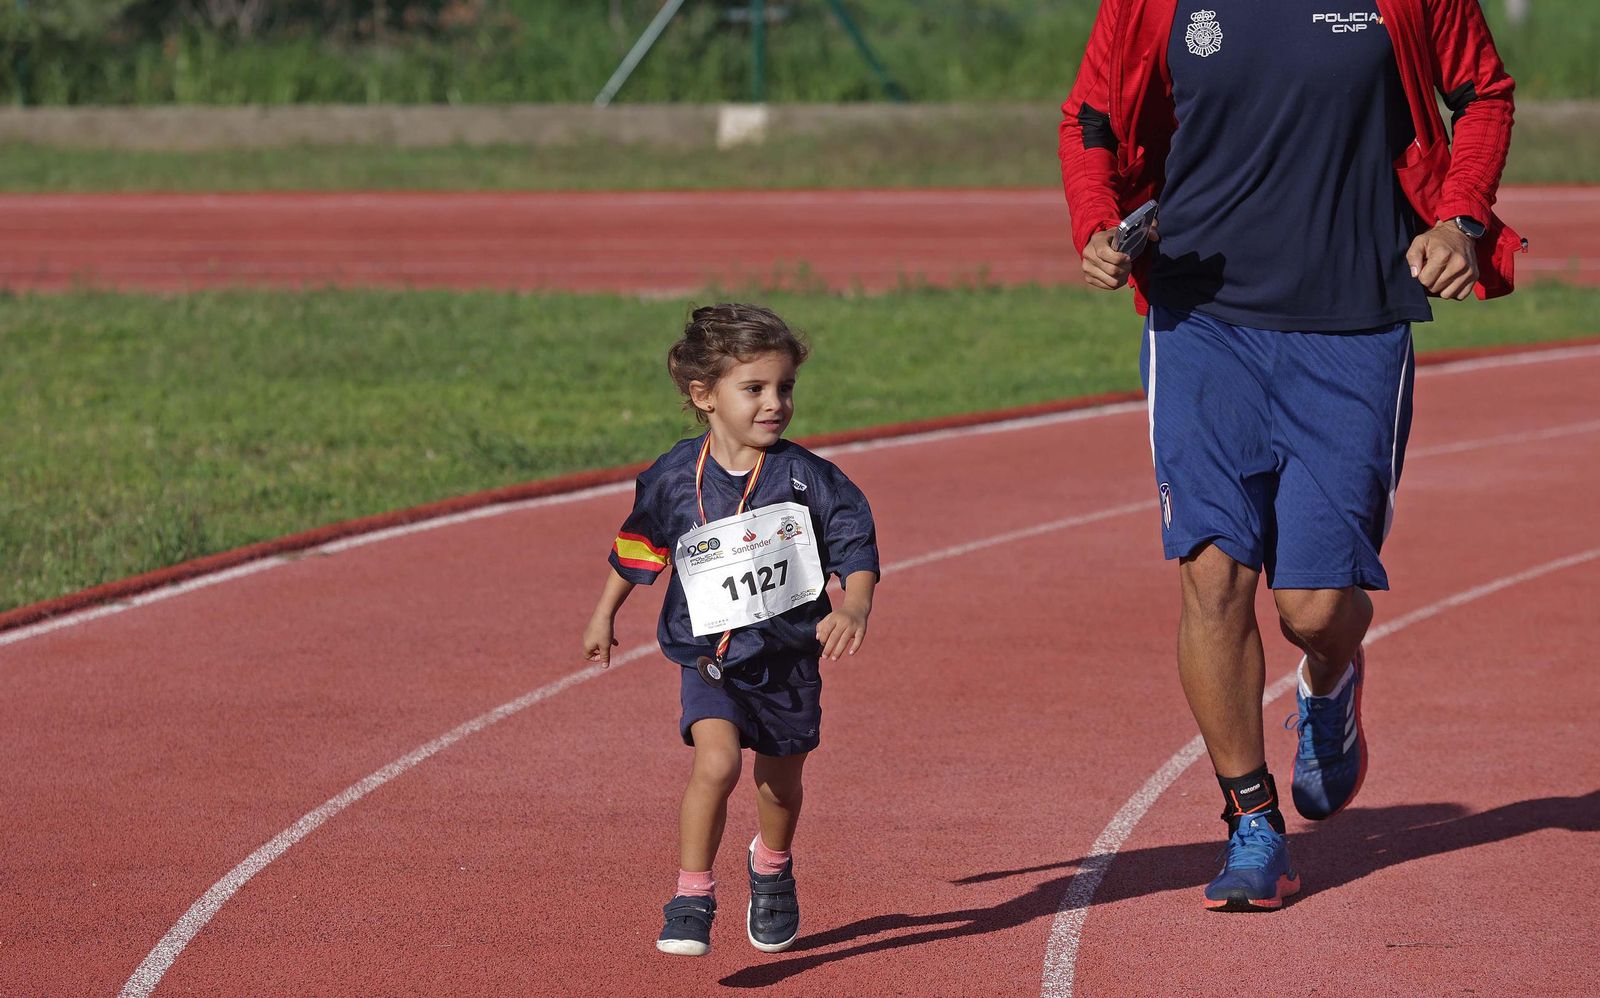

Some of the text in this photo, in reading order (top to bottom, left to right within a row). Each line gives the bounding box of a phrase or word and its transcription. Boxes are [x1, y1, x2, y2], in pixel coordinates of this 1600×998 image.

[1312, 12, 1378, 23] POLICIA
[1331, 23, 1367, 33] CNP
[731, 538, 772, 555] Santander
[721, 559, 789, 601] 1127
